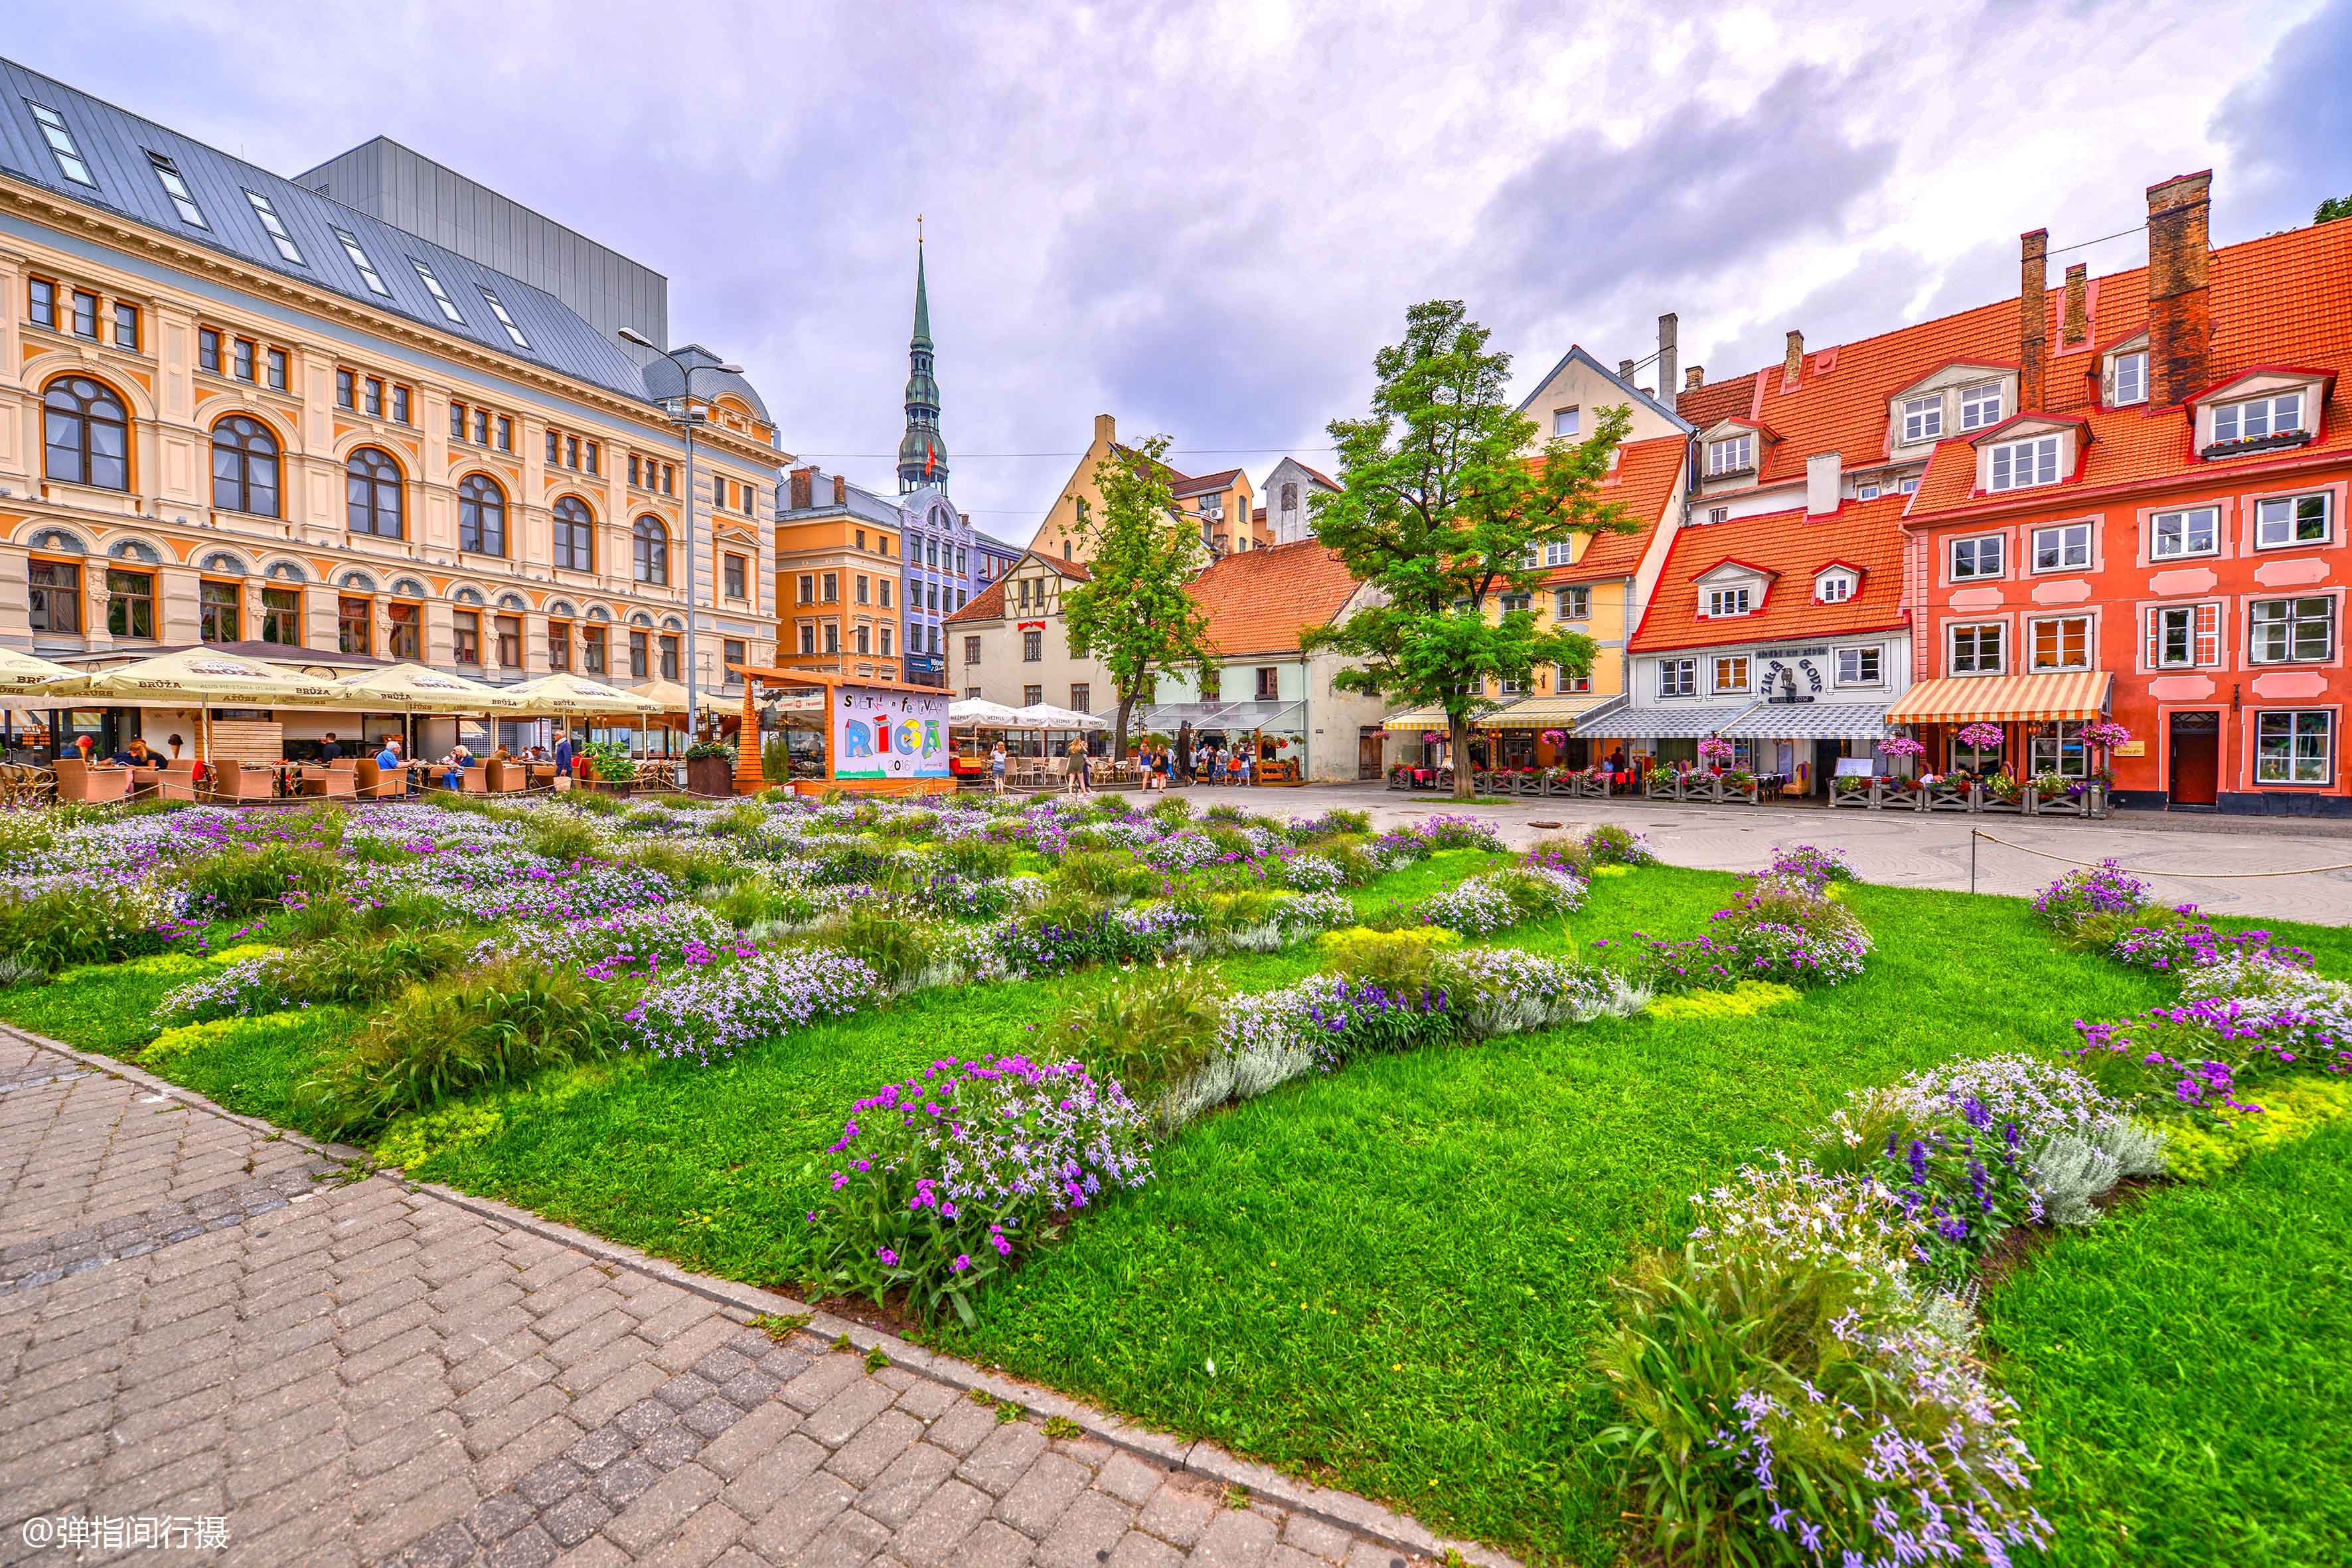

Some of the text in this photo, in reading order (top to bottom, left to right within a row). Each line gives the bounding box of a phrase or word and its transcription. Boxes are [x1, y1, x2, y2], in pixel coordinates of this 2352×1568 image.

[17, 675, 48, 684] BRŪ
[137, 680, 182, 688] BRŪŽA
[845, 714, 942, 759] RĪGĀ
[888, 759, 910, 771] 2016
